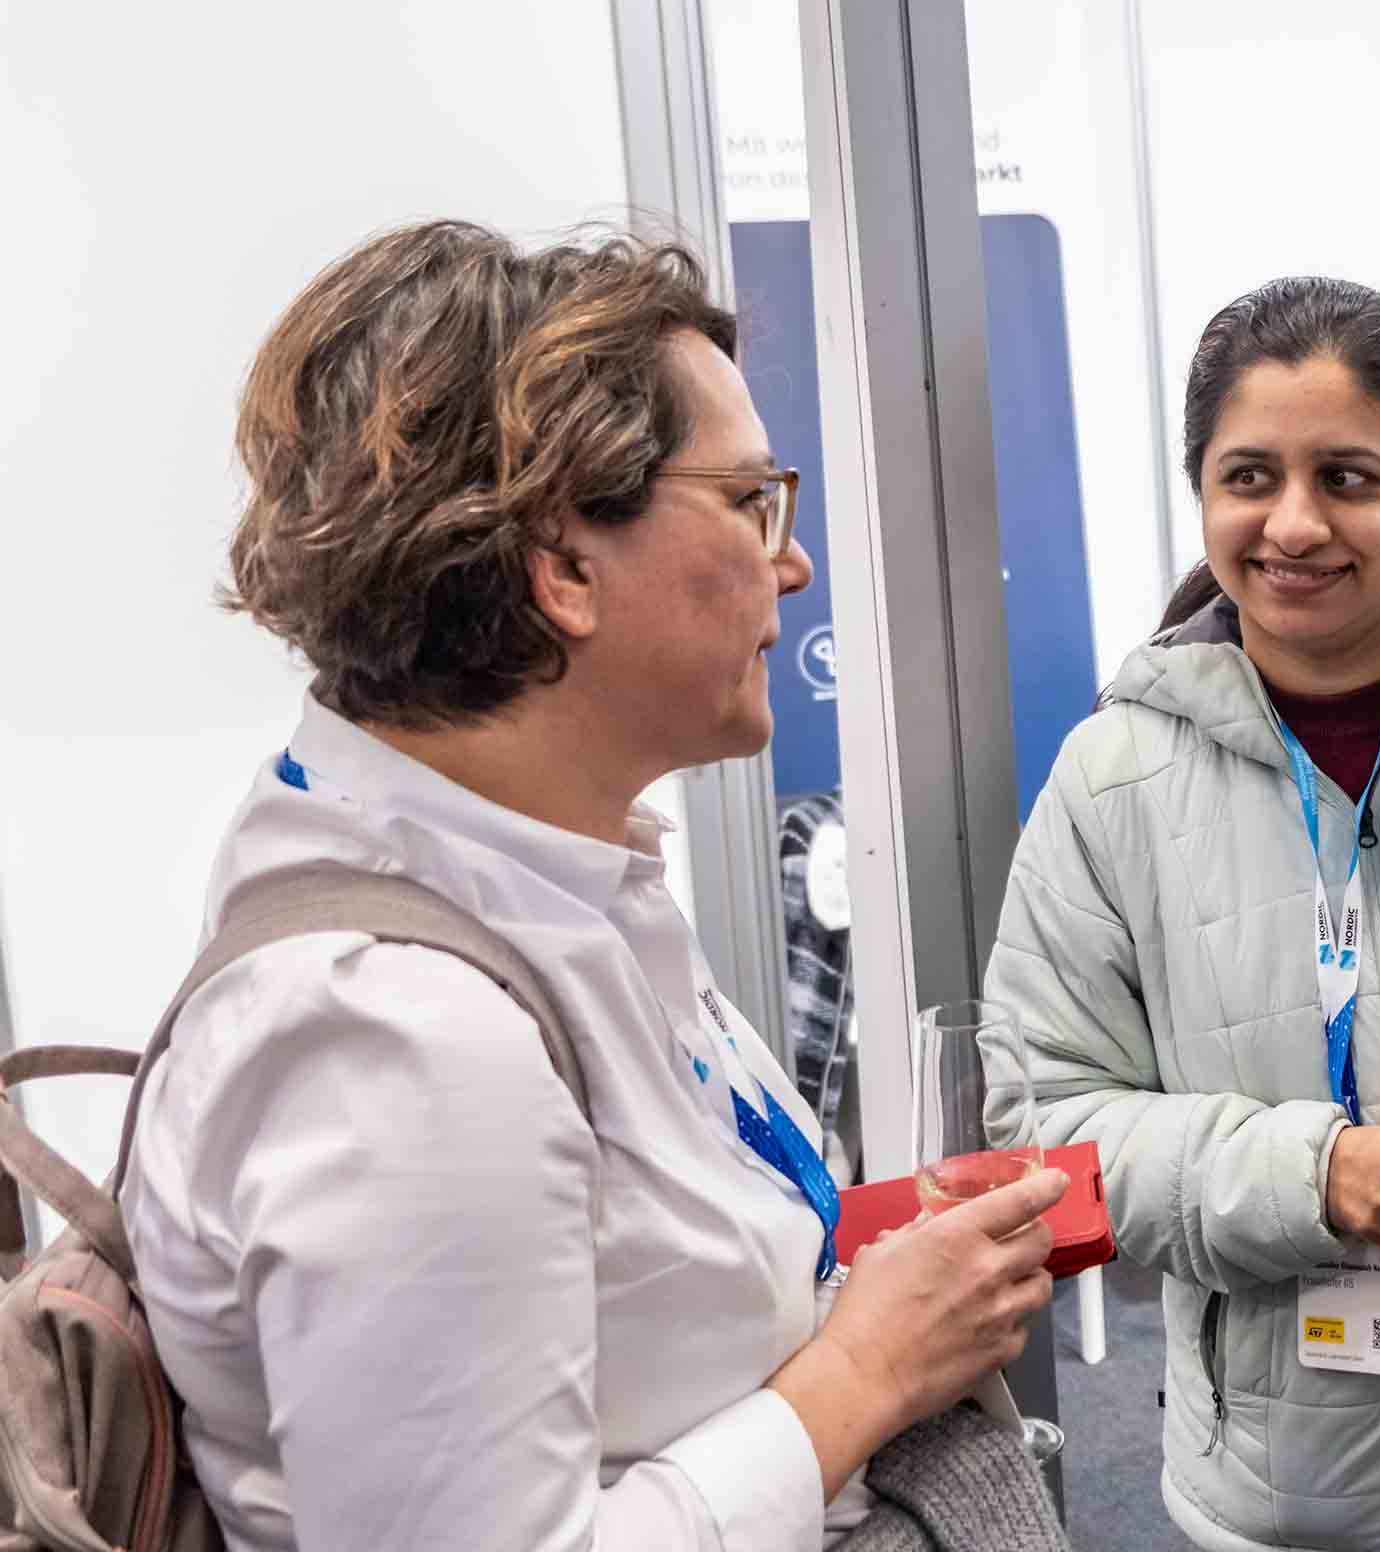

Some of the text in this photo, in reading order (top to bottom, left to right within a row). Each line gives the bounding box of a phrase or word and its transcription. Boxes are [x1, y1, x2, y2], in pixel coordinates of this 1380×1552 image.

[975, 162, 1024, 184] arkt
[1318, 903, 1326, 941] NORDIC
[1344, 906, 1355, 946] NORDIC
